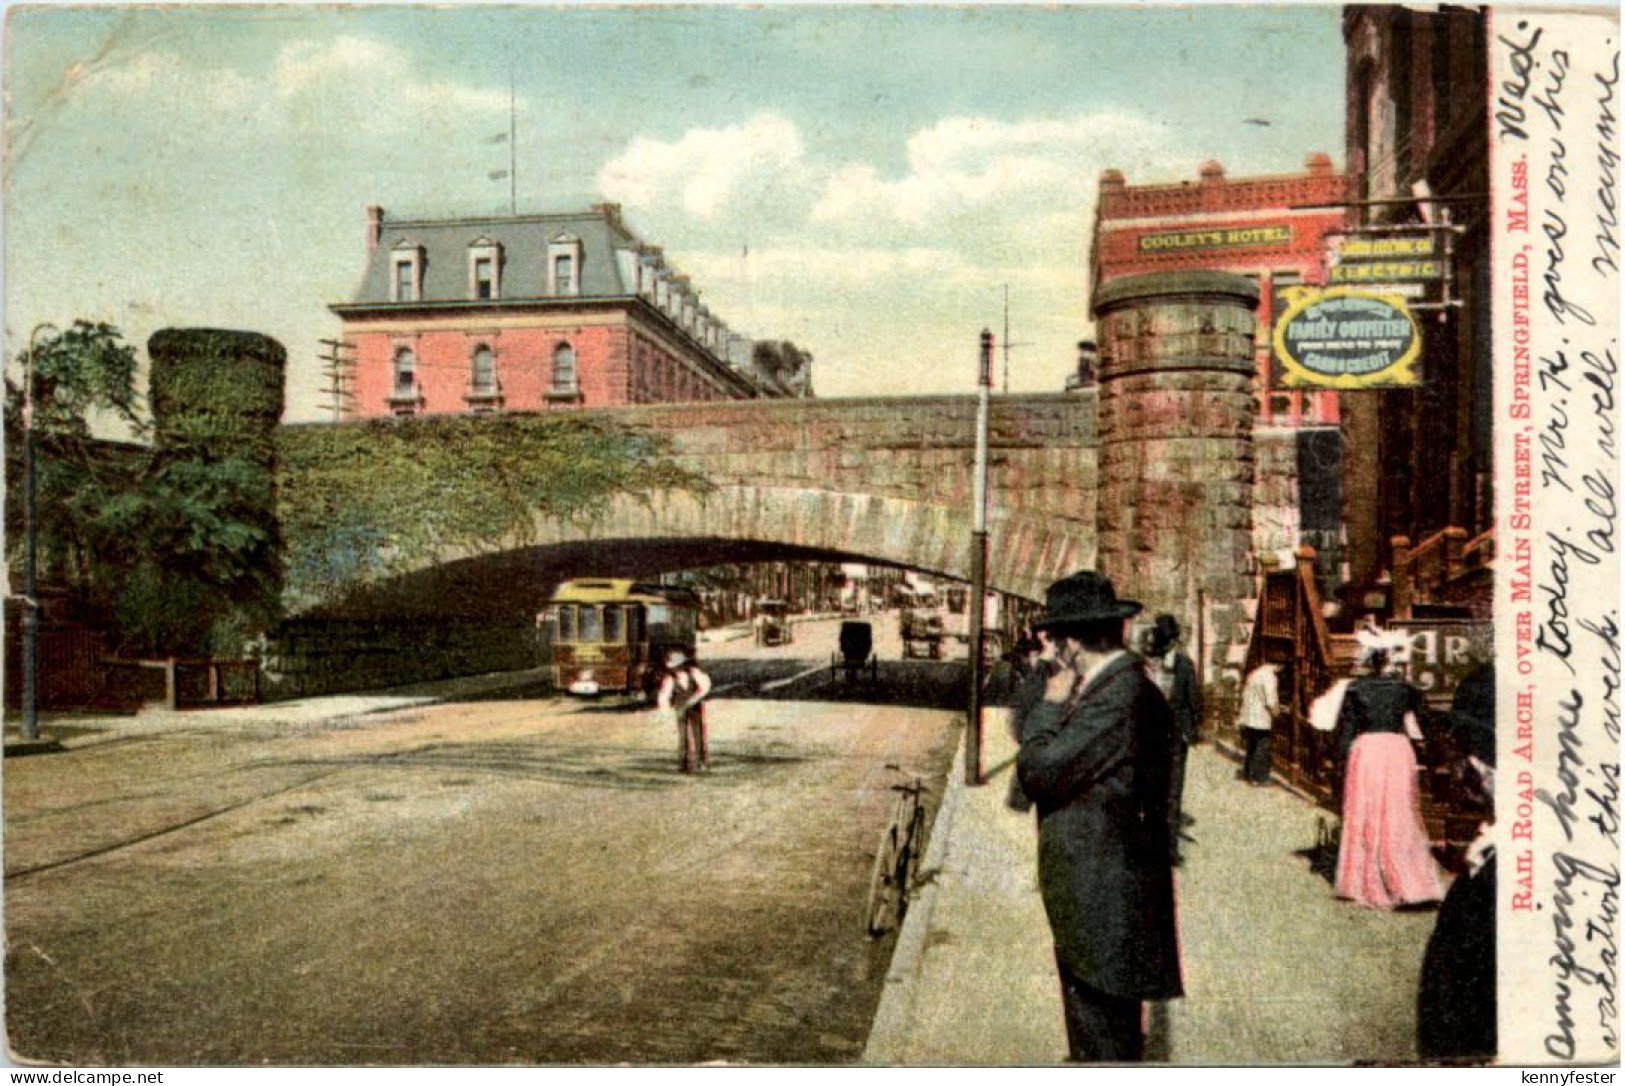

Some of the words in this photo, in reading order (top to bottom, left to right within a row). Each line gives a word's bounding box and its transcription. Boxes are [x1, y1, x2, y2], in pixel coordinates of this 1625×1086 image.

[1531, 49, 1570, 132] his
[1545, 138, 1569, 203] on
[1541, 208, 1597, 326] goes
[1537, 399, 1574, 493] Mr.
[1532, 689, 1585, 842] home
[1585, 762, 1620, 850] this
